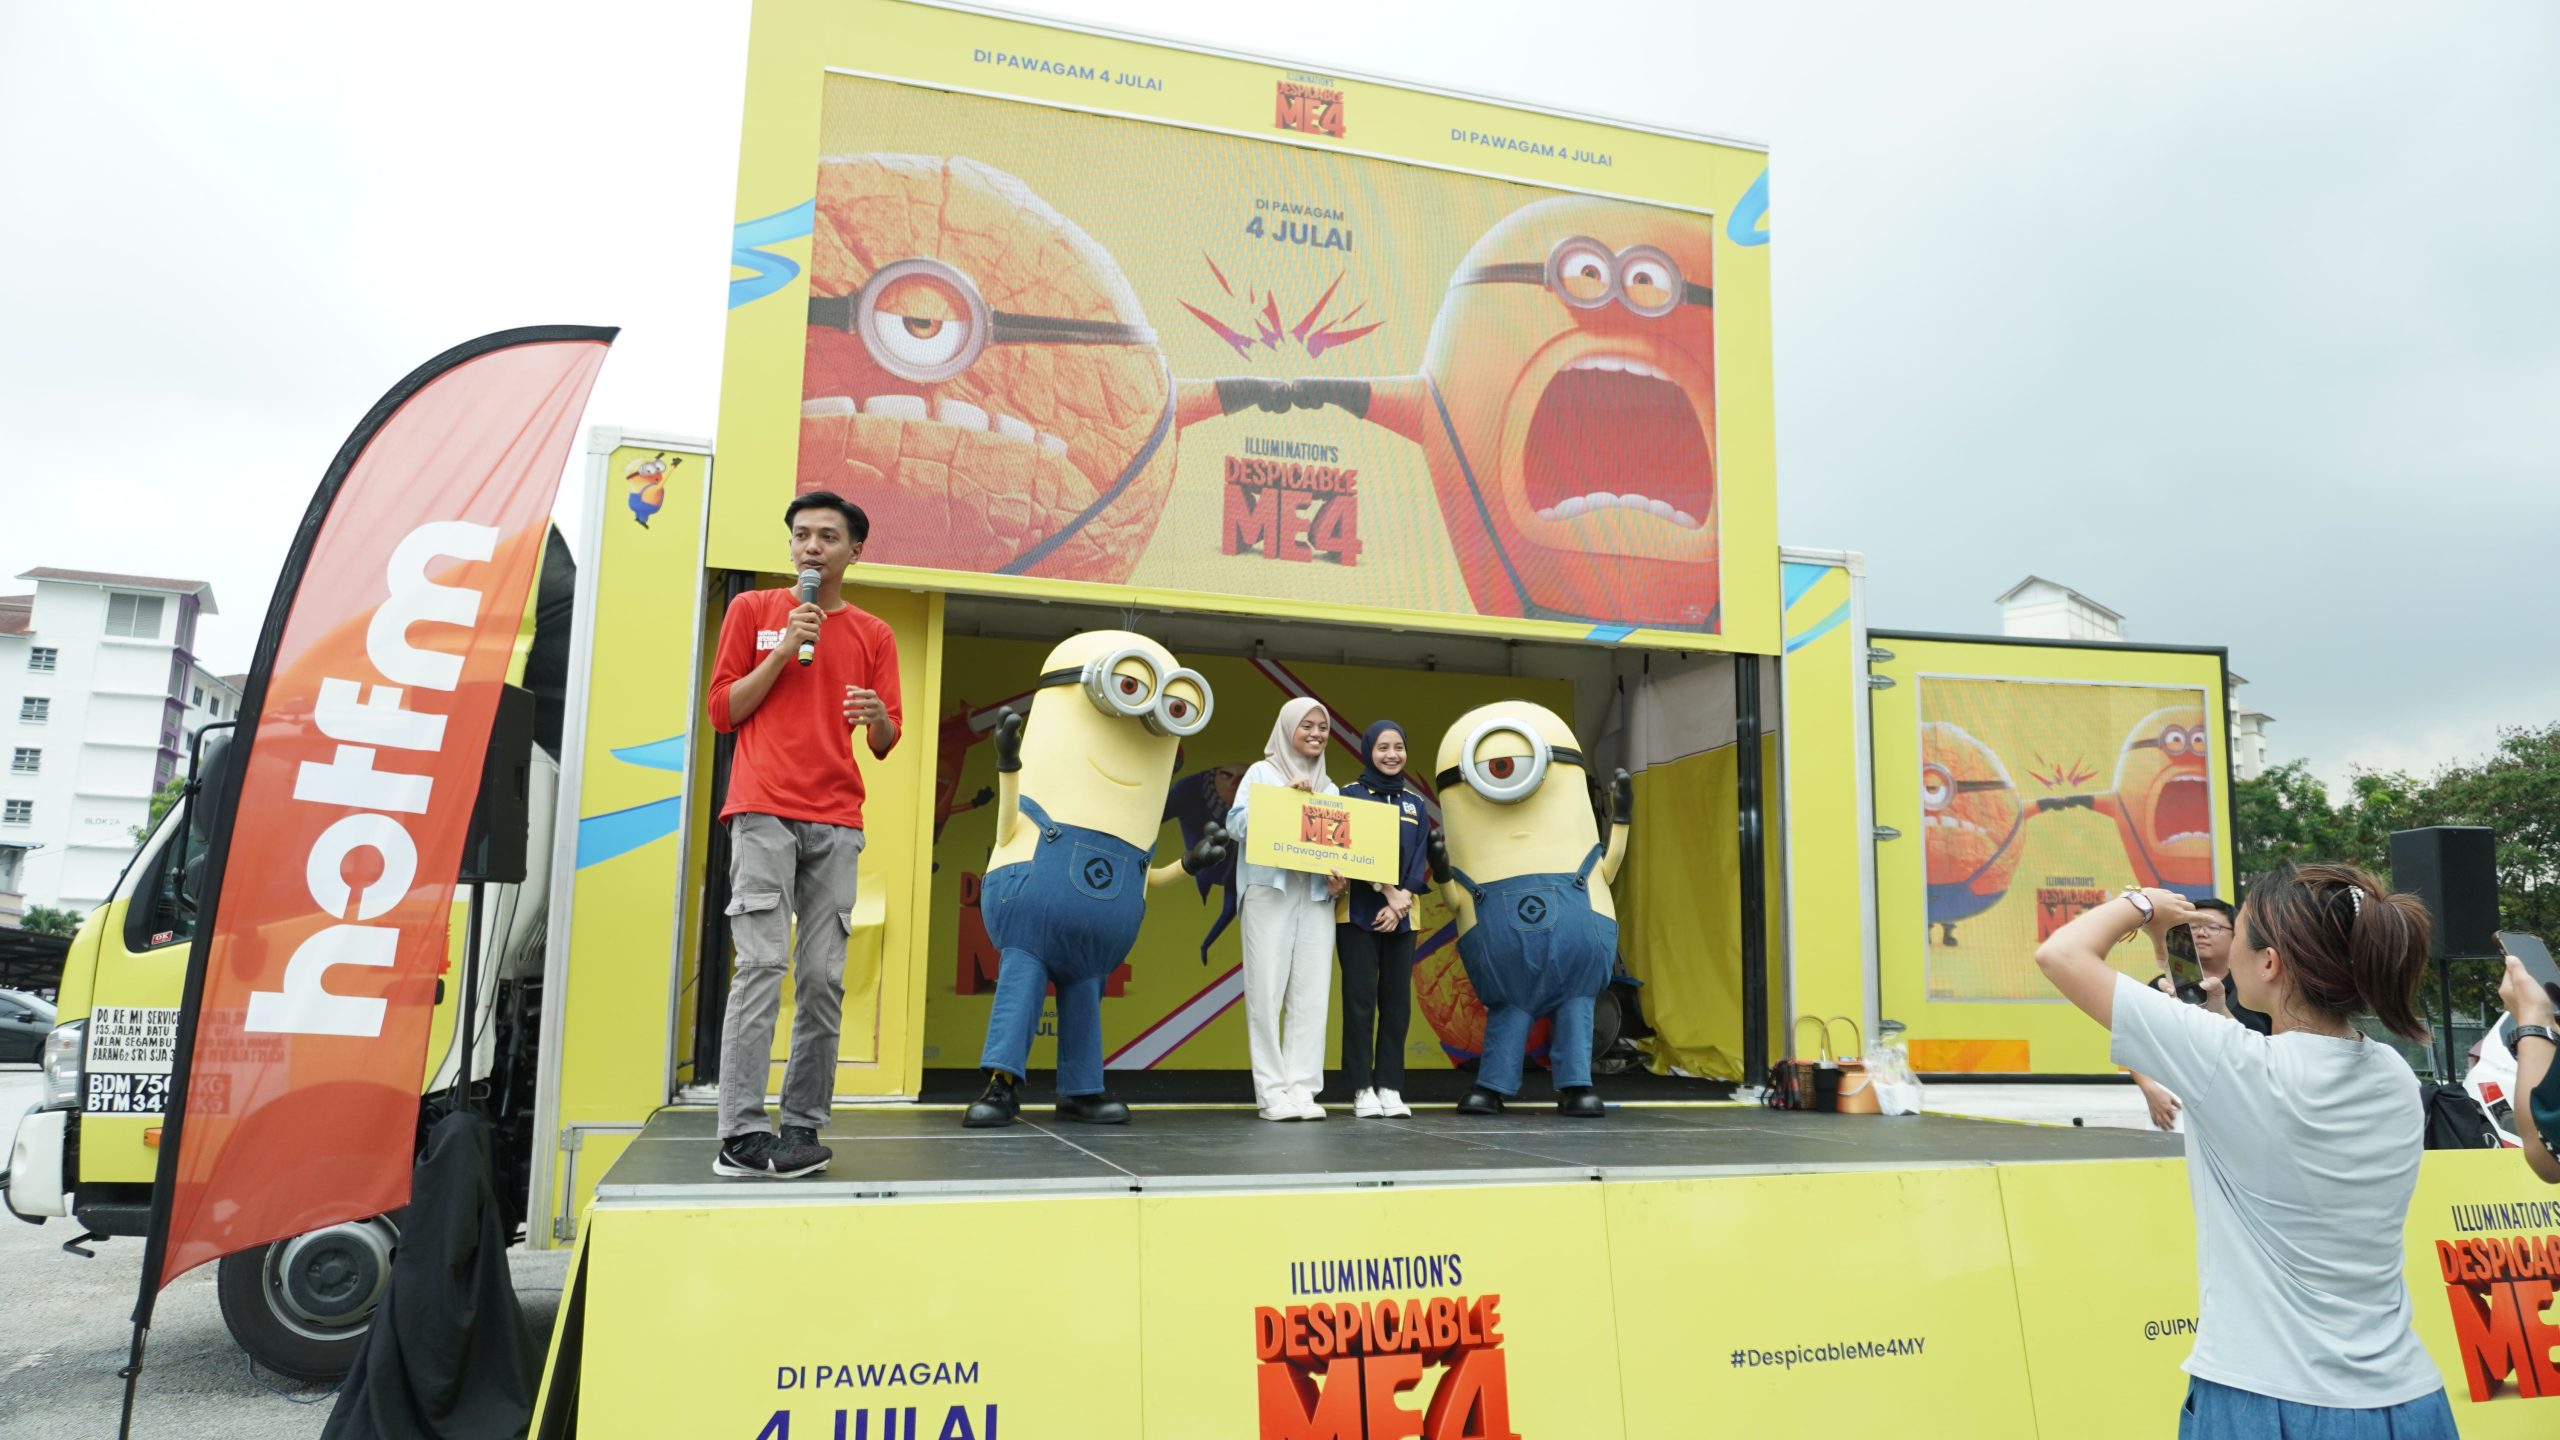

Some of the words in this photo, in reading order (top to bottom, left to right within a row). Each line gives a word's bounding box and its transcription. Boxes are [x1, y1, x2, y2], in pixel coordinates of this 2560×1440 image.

[974, 49, 992, 63] DI
[996, 52, 1095, 80] PAWAGAM
[1099, 70, 1110, 82] 4
[1114, 73, 1162, 91] JULAI
[1276, 80, 1345, 103] DESPICABLE
[1451, 128, 1467, 142] DI
[1470, 132, 1555, 157] PAWAGAM
[1558, 147, 1568, 159] 4
[1571, 150, 1613, 167] JULAI
[1256, 199, 1269, 210] DI
[1272, 201, 1344, 221] PAWAGAM
[1246, 216, 1264, 239] 4
[1272, 220, 1353, 252] JULAI
[1245, 437, 1339, 463] ILLUMINATION'S
[1225, 456, 1358, 496] DESPICABLE
[244, 520, 500, 1037] hotfm
[1273, 842, 1284, 852] Di
[1286, 844, 1339, 860] Pawagam
[1341, 852, 1348, 861] 4
[1350, 854, 1375, 865] Julai
[97, 1009, 109, 1023] DO
[113, 1009, 125, 1024] RE
[129, 1010, 143, 1024] MI
[147, 1026, 170, 1036] BATU
[94, 1036, 122, 1046] JALAN
[125, 1037, 176, 1047] SEGAMBU
[89, 1075, 131, 1094] BDM
[87, 1094, 130, 1112] BTM
[133, 1094, 168, 1112] 34
[2451, 1201, 2560, 1232] ILLUMINATION'S
[1291, 1254, 1462, 1295] ILLUMINATION'S
[1255, 1294, 1504, 1361] DESPICABLE
[1731, 1337, 1925, 1370] #DespicableMe4MY
[777, 1366, 806, 1390] DI
[816, 1361, 979, 1389] PAWAGAM
